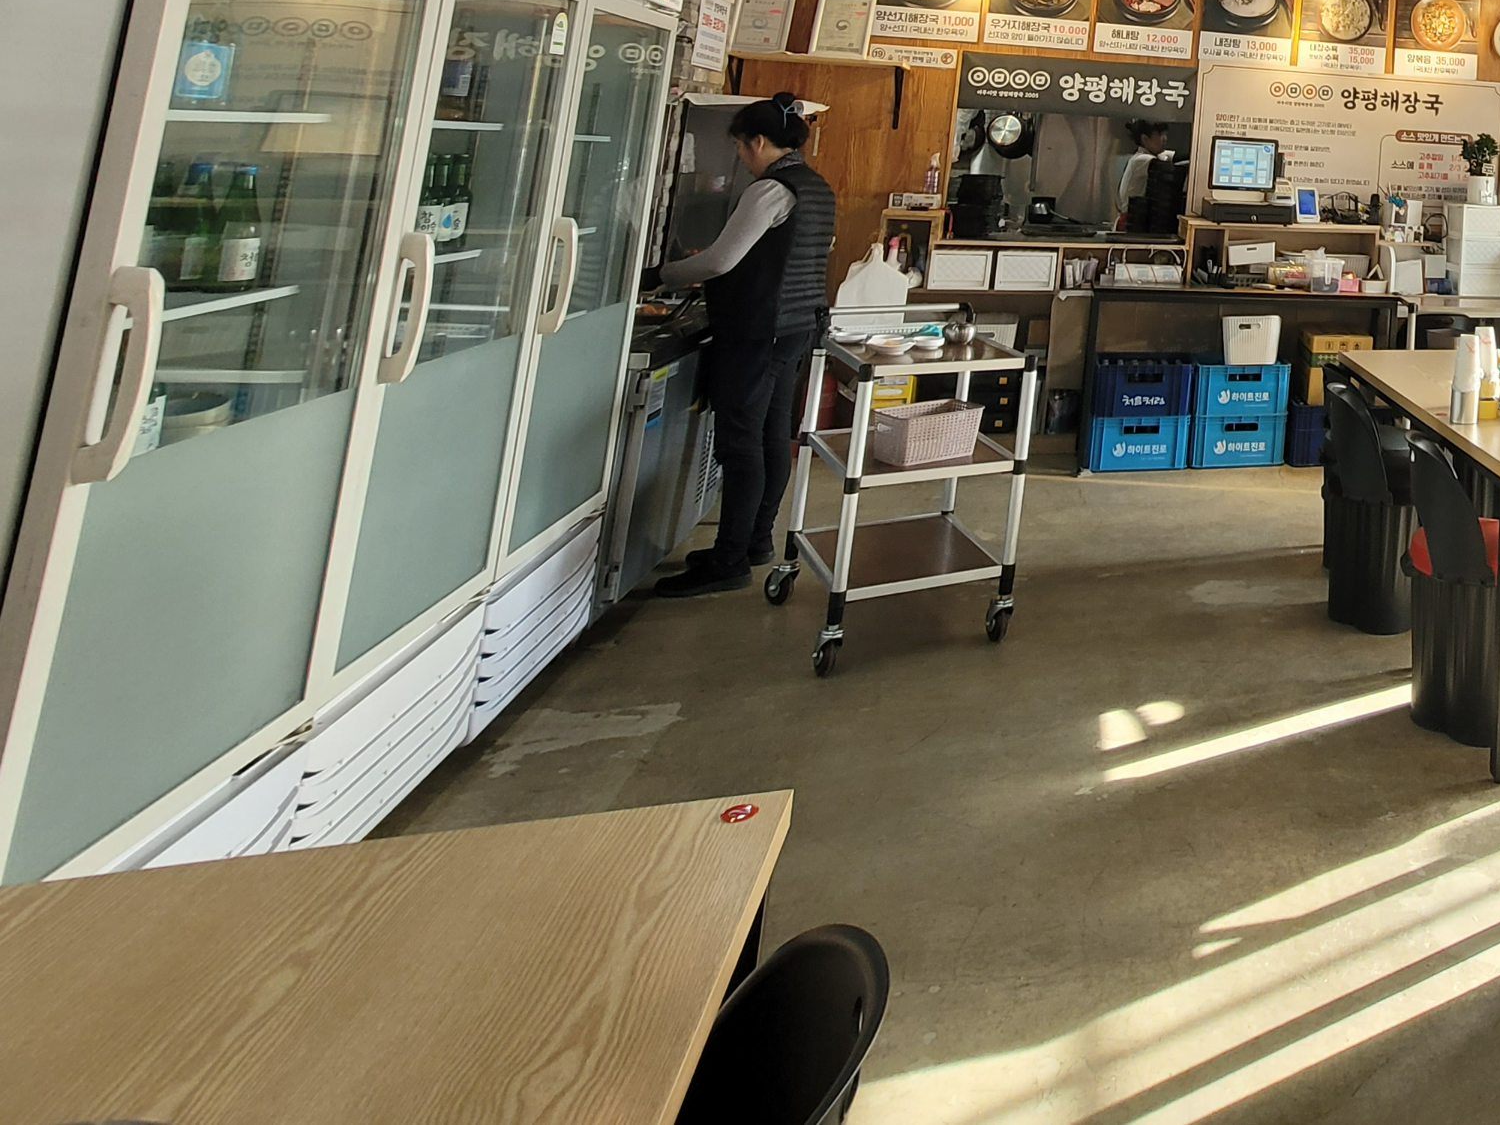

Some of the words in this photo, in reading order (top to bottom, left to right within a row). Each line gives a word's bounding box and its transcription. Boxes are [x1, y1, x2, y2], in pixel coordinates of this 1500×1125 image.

[876, 10, 939, 25] 양선지해장국
[943, 15, 974, 27] 11,000
[990, 18, 1051, 33] 우거지해장국
[1111, 29, 1140, 40] 해내탕
[1214, 37, 1241, 49] 내장탕
[1246, 40, 1277, 52] 13,000
[1348, 47, 1375, 57] 35,000
[1324, 53, 1339, 62] 수육
[1349, 56, 1375, 65] 15,000
[1435, 56, 1466, 67] 35,000
[1058, 72, 1190, 109] 양평해장국
[1340, 87, 1444, 116] 양평해장국
[1400, 131, 1416, 141] 소스
[1417, 133, 1439, 143] 맛있게
[1391, 160, 1414, 170] 소스에
[1231, 391, 1270, 402] 하이트진로
[1127, 443, 1168, 455] 하이트진로
[1227, 441, 1266, 453] 하이트진로
